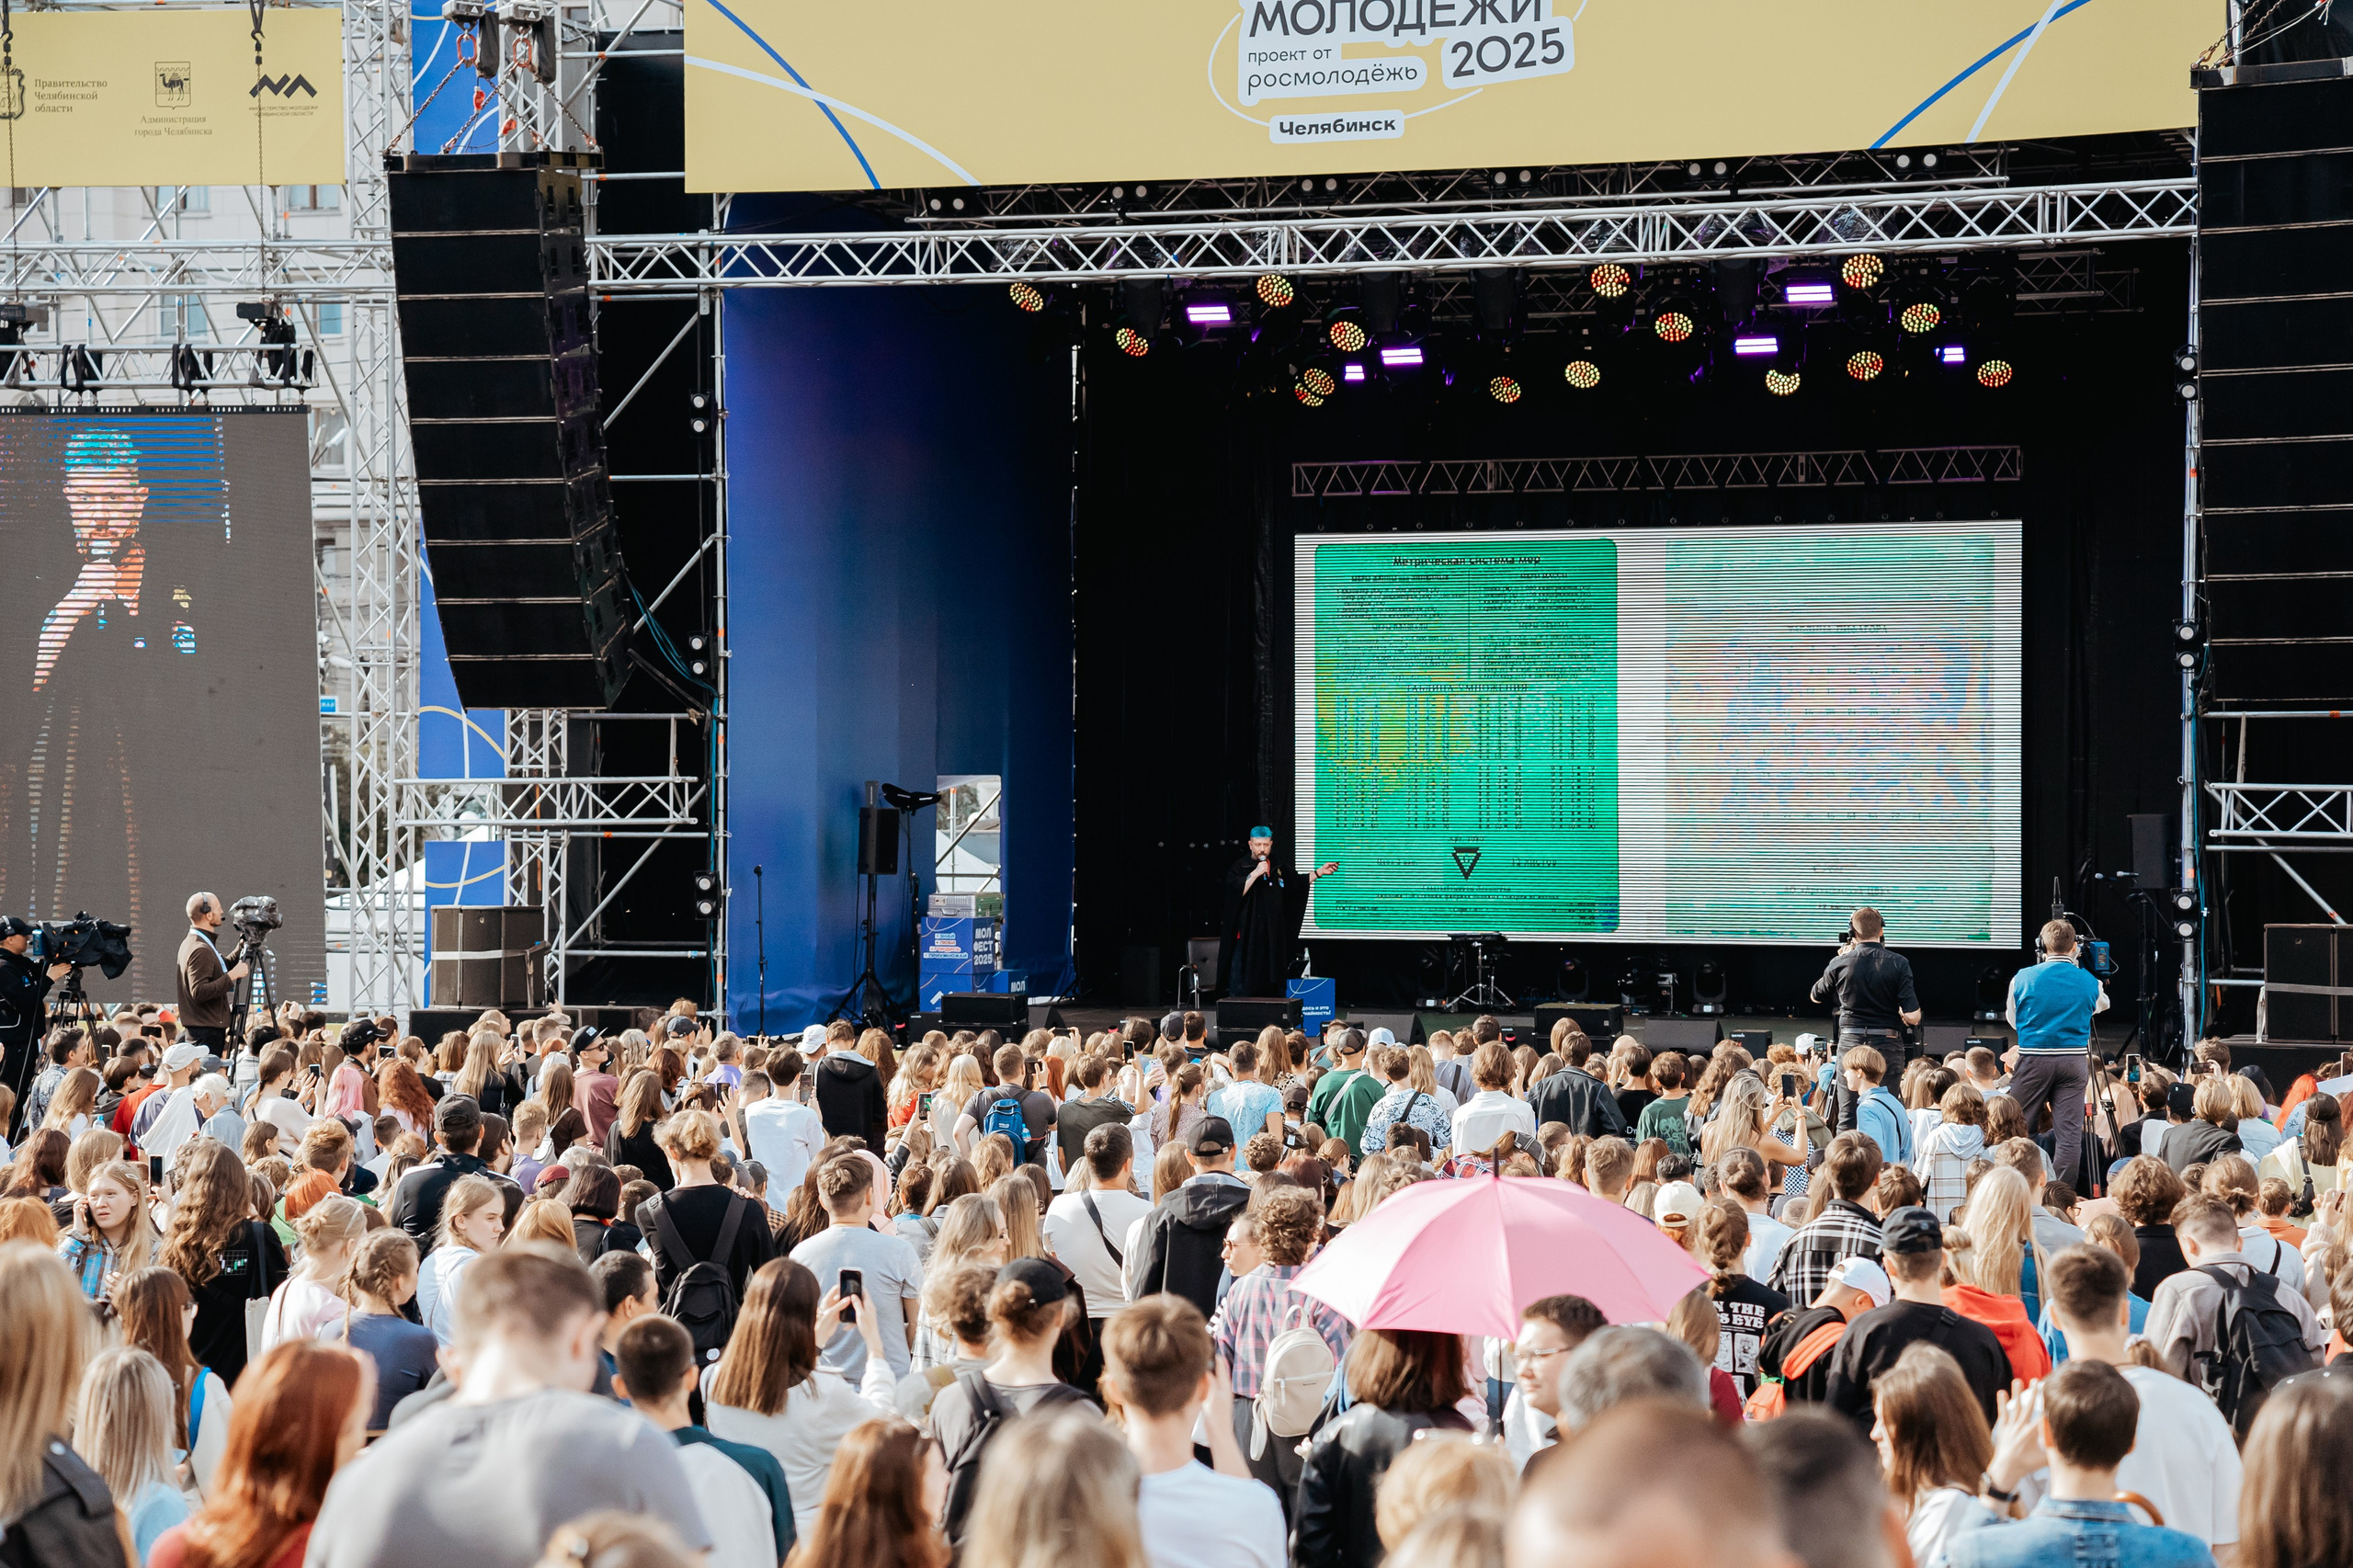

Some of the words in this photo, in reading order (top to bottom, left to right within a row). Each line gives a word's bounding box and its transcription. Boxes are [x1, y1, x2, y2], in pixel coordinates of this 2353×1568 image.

[1247, 50, 1307, 66] проект
[1312, 47, 1333, 61] от
[1450, 27, 1565, 78] 2025
[34, 78, 108, 89] Правительство
[1247, 62, 1418, 96] росмолодёжь
[34, 90, 99, 101] Челябинской
[34, 104, 74, 113] области
[140, 115, 208, 126] Администрация
[134, 129, 163, 138] города
[164, 127, 213, 137] Челябинска
[1279, 118, 1397, 136] Челябинск
[975, 927, 992, 939] МОЛ
[972, 940, 994, 952] ФЕСТ
[973, 953, 993, 966] 2025
[1712, 1301, 1724, 1312] N
[1729, 1301, 1766, 1318] THE
[1732, 1314, 1765, 1329] EYE
